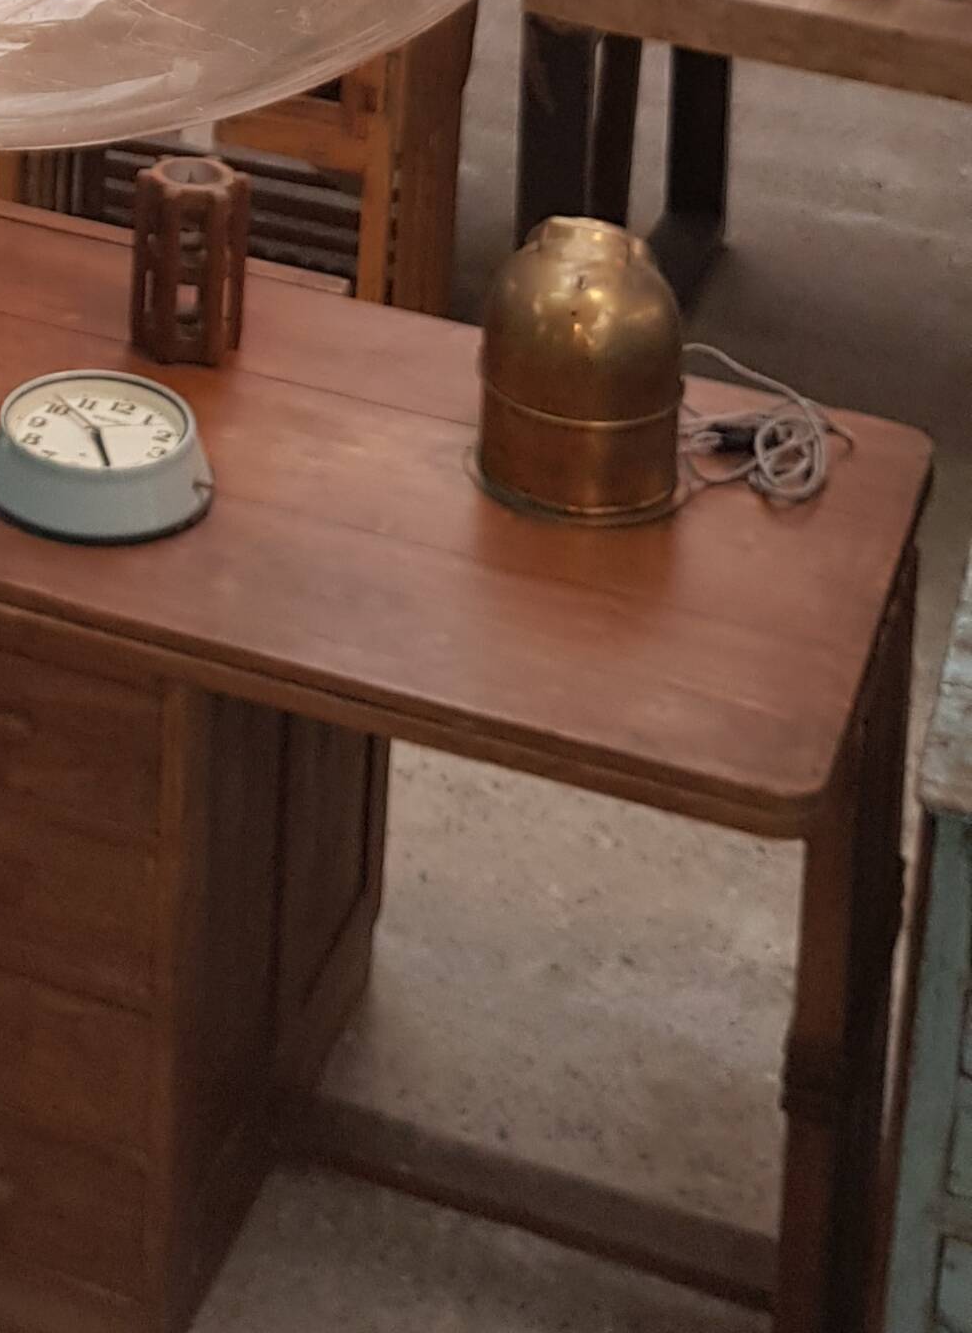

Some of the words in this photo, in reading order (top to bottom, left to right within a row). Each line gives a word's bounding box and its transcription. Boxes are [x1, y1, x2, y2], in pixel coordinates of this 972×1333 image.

[77, 398, 97, 411] 11
[110, 401, 137, 415] 12
[152, 429, 172, 443] 2
